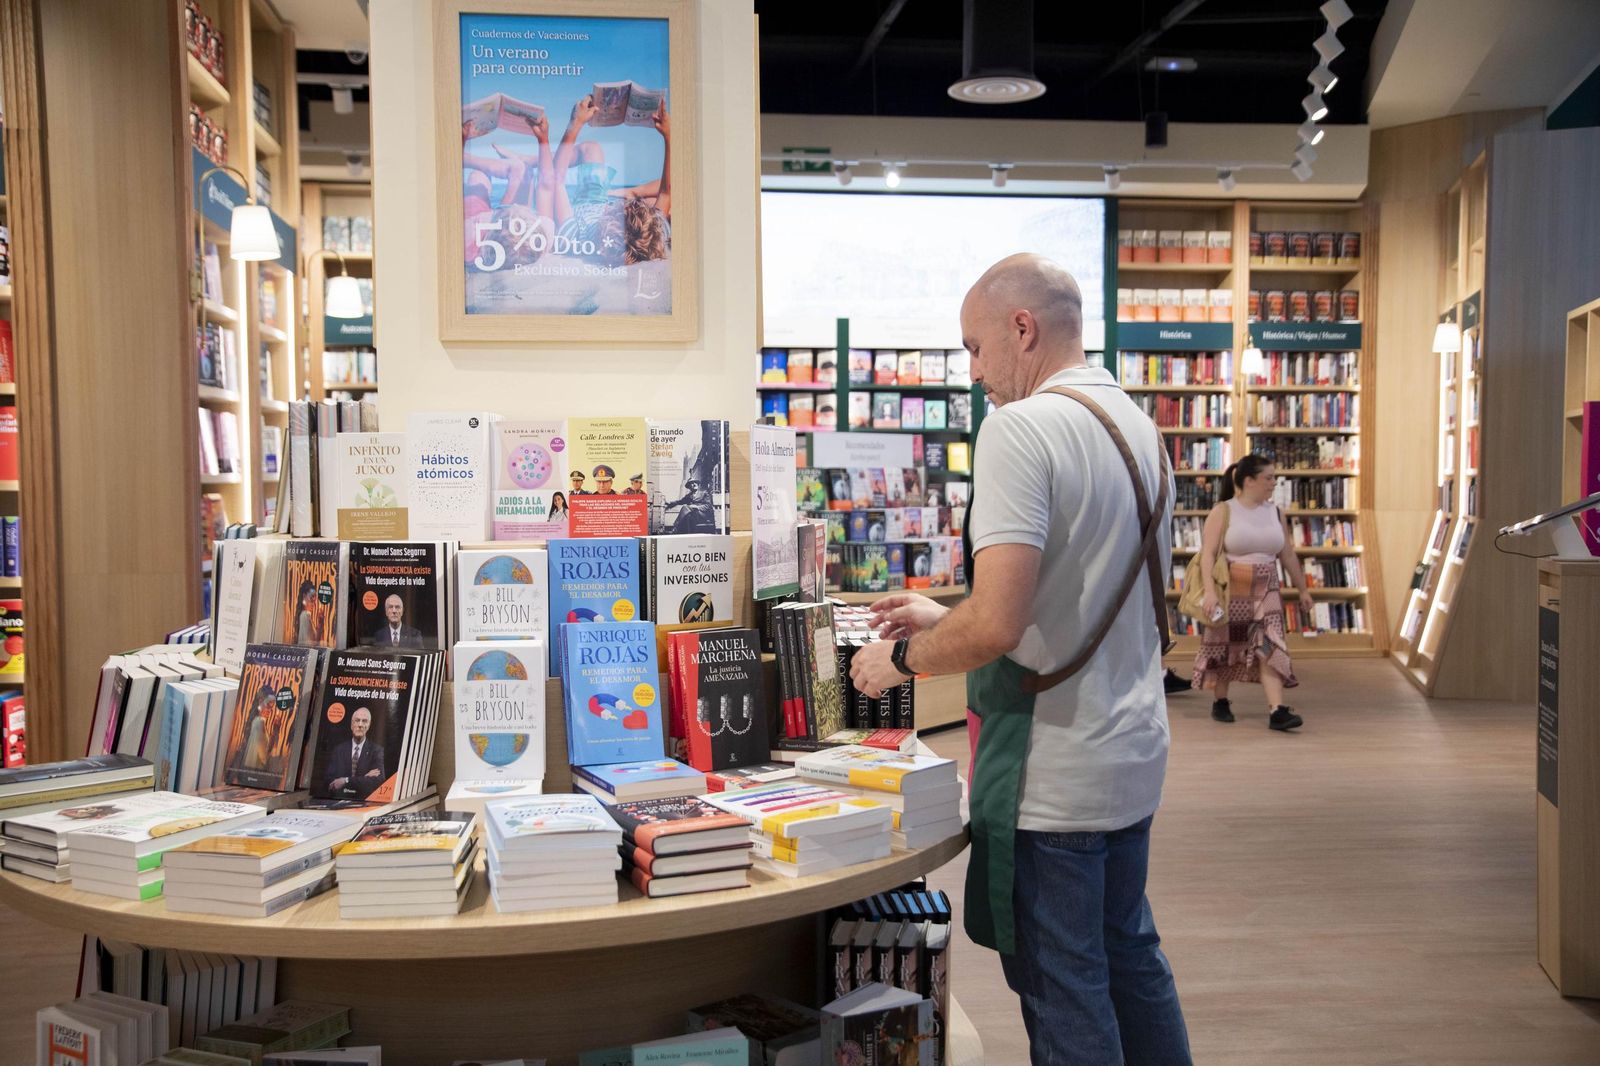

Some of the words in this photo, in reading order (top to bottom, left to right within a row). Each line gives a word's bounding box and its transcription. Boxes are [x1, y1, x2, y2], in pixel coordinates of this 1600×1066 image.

[472, 29, 522, 39] Cuadernos
[524, 31, 535, 40] de
[537, 31, 589, 41] Vacaciones
[472, 45, 494, 58] Un
[498, 48, 549, 60] verano
[473, 63, 505, 77] para
[509, 62, 583, 79] compartir
[514, 263, 580, 277] Exclusivo
[584, 264, 628, 277] Socios
[598, 433, 625, 441] Londres
[349, 446, 400, 456] INFINITO
[651, 450, 673, 458] Zweig
[755, 441, 770, 455] Hola
[421, 453, 469, 465] Hábitos
[355, 465, 395, 475] JUNCO
[416, 468, 474, 479] atómicos
[524, 496, 530, 505] A
[532, 496, 542, 505] LA
[371, 547, 389, 556] Manuel
[390, 548, 403, 556] Sans
[404, 548, 427, 558] Segarra
[560, 545, 629, 559] ENRIQUE
[667, 553, 702, 563] HAZLO
[704, 552, 726, 562] BIEN
[288, 558, 337, 578] PIRÓMANAS
[360, 566, 366, 574] La
[367, 566, 413, 574] SUPRACONCIENCIA
[414, 566, 431, 574] existe
[560, 562, 630, 579] ROJAS
[699, 563, 711, 572] tus
[365, 576, 376, 585] Vida
[377, 577, 398, 587] después
[399, 577, 405, 585] de
[406, 577, 412, 585] la
[413, 577, 425, 585] vida
[664, 573, 729, 585] INVERSIONES
[496, 588, 514, 602] BILL
[482, 604, 530, 624] BRYSON
[579, 629, 647, 644] ENRIQUE
[698, 638, 748, 652] MANUEL
[247, 651, 270, 659] NOEMÍ
[273, 654, 305, 662] CASQUET
[580, 645, 649, 665] ROJAS
[691, 650, 757, 665] MARCHENA
[337, 657, 345, 666] Dr.
[346, 657, 367, 667] Manuel
[368, 659, 382, 668] Sans
[382, 660, 406, 671] Segarra
[244, 663, 303, 687] PIRÓMANAS
[582, 668, 625, 676] REMEDIOS
[709, 666, 718, 674] La
[719, 665, 742, 676] justicia
[330, 676, 336, 685] La
[338, 676, 388, 687] SUPRACONCIENCIA
[602, 675, 641, 683] DESAMOR
[704, 672, 748, 683] AMENAZADA
[335, 688, 347, 697] Vida
[347, 688, 370, 699] después
[371, 690, 378, 698] de
[380, 690, 385, 699] la
[386, 690, 399, 700] vida
[490, 684, 508, 698] BILL
[476, 701, 524, 720] BRYSON
